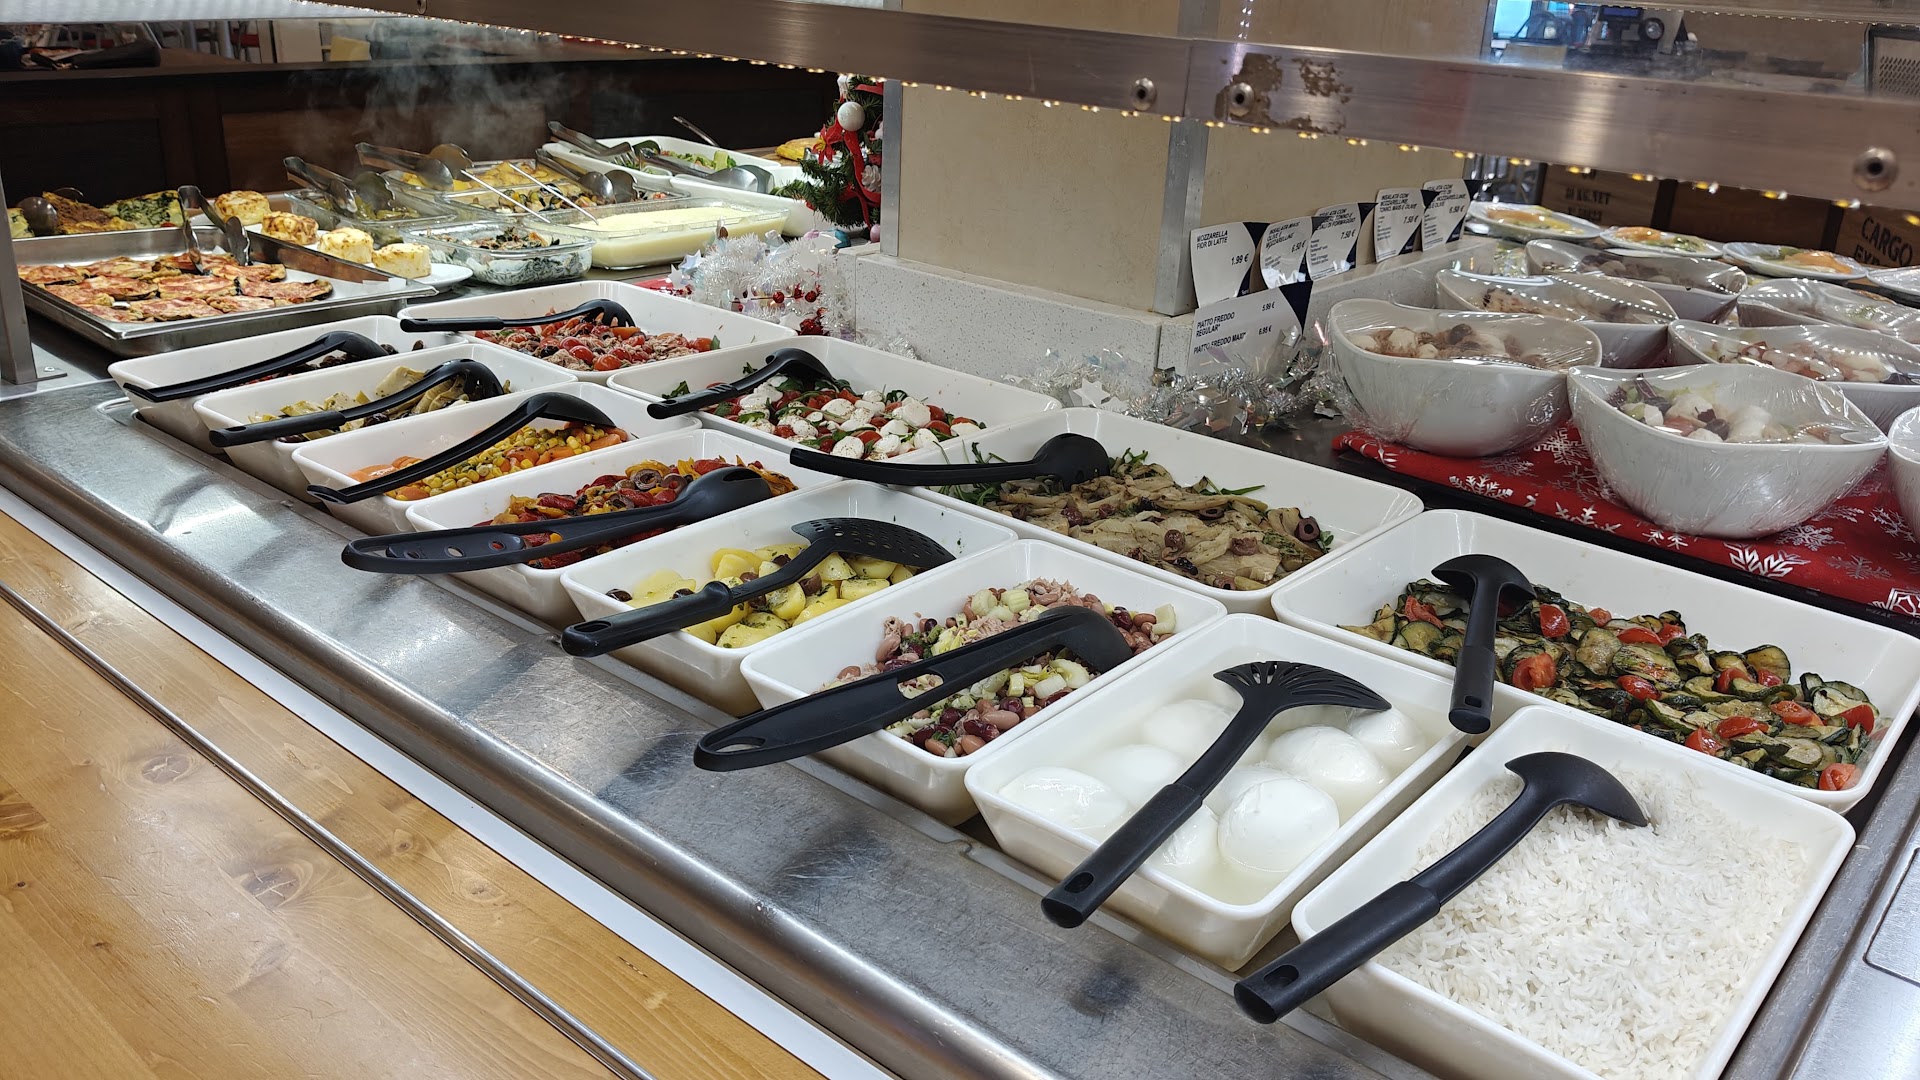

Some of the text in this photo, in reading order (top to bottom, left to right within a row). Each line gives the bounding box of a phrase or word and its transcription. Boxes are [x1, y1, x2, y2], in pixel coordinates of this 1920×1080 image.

[1197, 230, 1228, 242] MOZZARELLA
[1197, 241, 1207, 250] FIOR
[1213, 237, 1228, 246] LATTE
[1861, 216, 1913, 267] CARGO
[1231, 253, 1249, 265] 1.99 €
[1196, 317, 1213, 329] PIATTO
[1213, 311, 1235, 325] FREDDO
[1193, 344, 1210, 355] PIATTO
[1210, 336, 1232, 348] FREDDO
